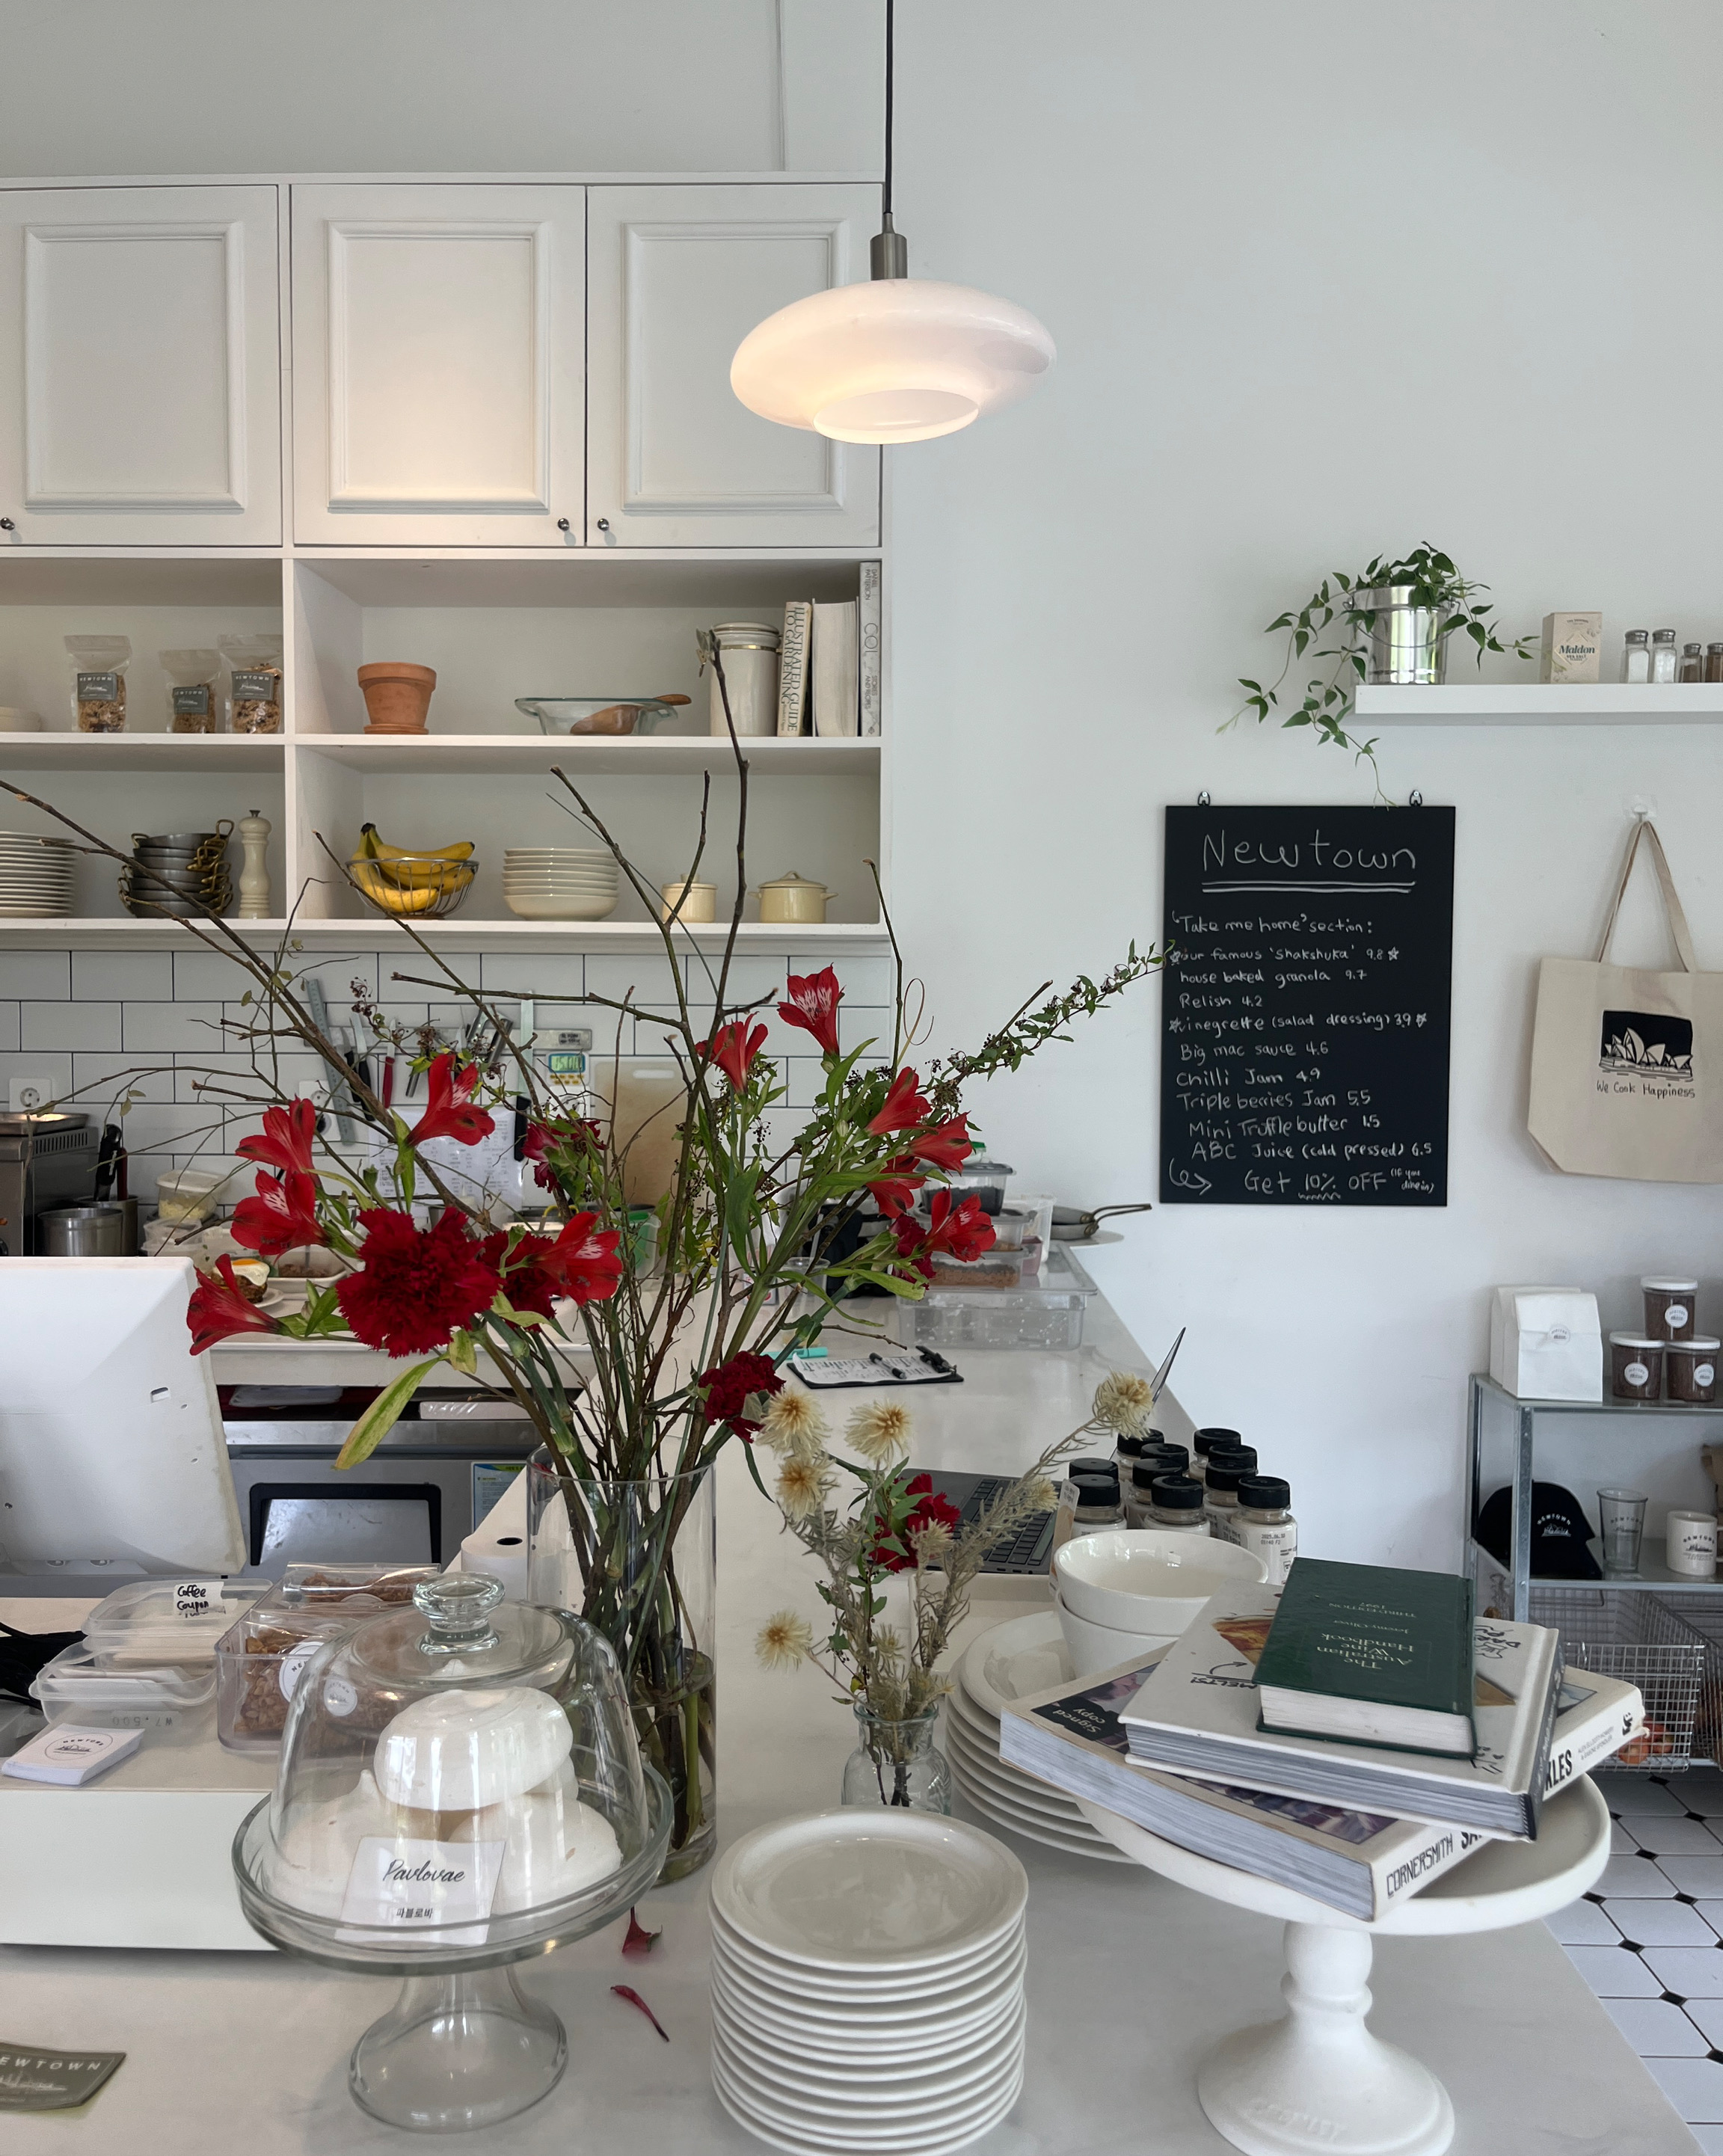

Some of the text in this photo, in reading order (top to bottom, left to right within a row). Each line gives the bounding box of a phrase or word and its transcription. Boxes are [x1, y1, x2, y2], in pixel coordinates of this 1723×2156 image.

[781, 610, 795, 704] TO GARDENING
[1558, 645, 1595, 654] Maldon
[787, 606, 805, 732] ILLUSTRATED GUIDE
[1204, 829, 1415, 870] Newtown
[1226, 922, 1253, 930] me
[1211, 948, 1262, 959] famous
[1366, 949, 1383, 959] 9.8
[1181, 969, 1366, 989] house baked granola 9.7
[1180, 994, 1262, 1008] Relish 4.2
[1272, 1014, 1314, 1028] (salad
[1327, 1013, 1389, 1031] dressing)
[1395, 1013, 1410, 1028] 3.9
[1181, 1042, 1328, 1066] Big mac sauce 4.6
[1177, 1068, 1320, 1086] Chilli Jam 4.9
[1597, 1080, 1695, 1099] We Cook Happiness
[1177, 1090, 1370, 1112] Triple berries Jam 5.5
[1190, 1114, 1380, 1138] Mini Truffle butter 1.5
[1192, 1141, 1431, 1161] ABC Juice (cold pressed) 6.5
[1245, 1170, 1386, 1194] Get 10% OFF
[1405, 1170, 1420, 1180] you
[1537, 1513, 1571, 1525] NEWTOWN
[177, 1584, 206, 1598] Coffee
[176, 1600, 209, 1612] Coupon
[1334, 1620, 1409, 1634] Jeremy Oliver
[1321, 1633, 1413, 1653] Handbook
[1341, 1643, 1389, 1656] Wine
[1316, 1646, 1413, 1666] Australian
[1343, 1657, 1382, 1670] The
[1191, 1676, 1258, 1689] MELTS!
[1053, 1710, 1101, 1733] Signed
[1072, 1708, 1105, 1724] copy
[1545, 1748, 1573, 1792] KLES
[382, 1858, 465, 1882] Pavlovae
[1386, 1834, 1454, 1898] CORNERSMITH
[396, 1907, 433, 1918] 파블로바
[0, 2057, 101, 2071] EWTOWN
